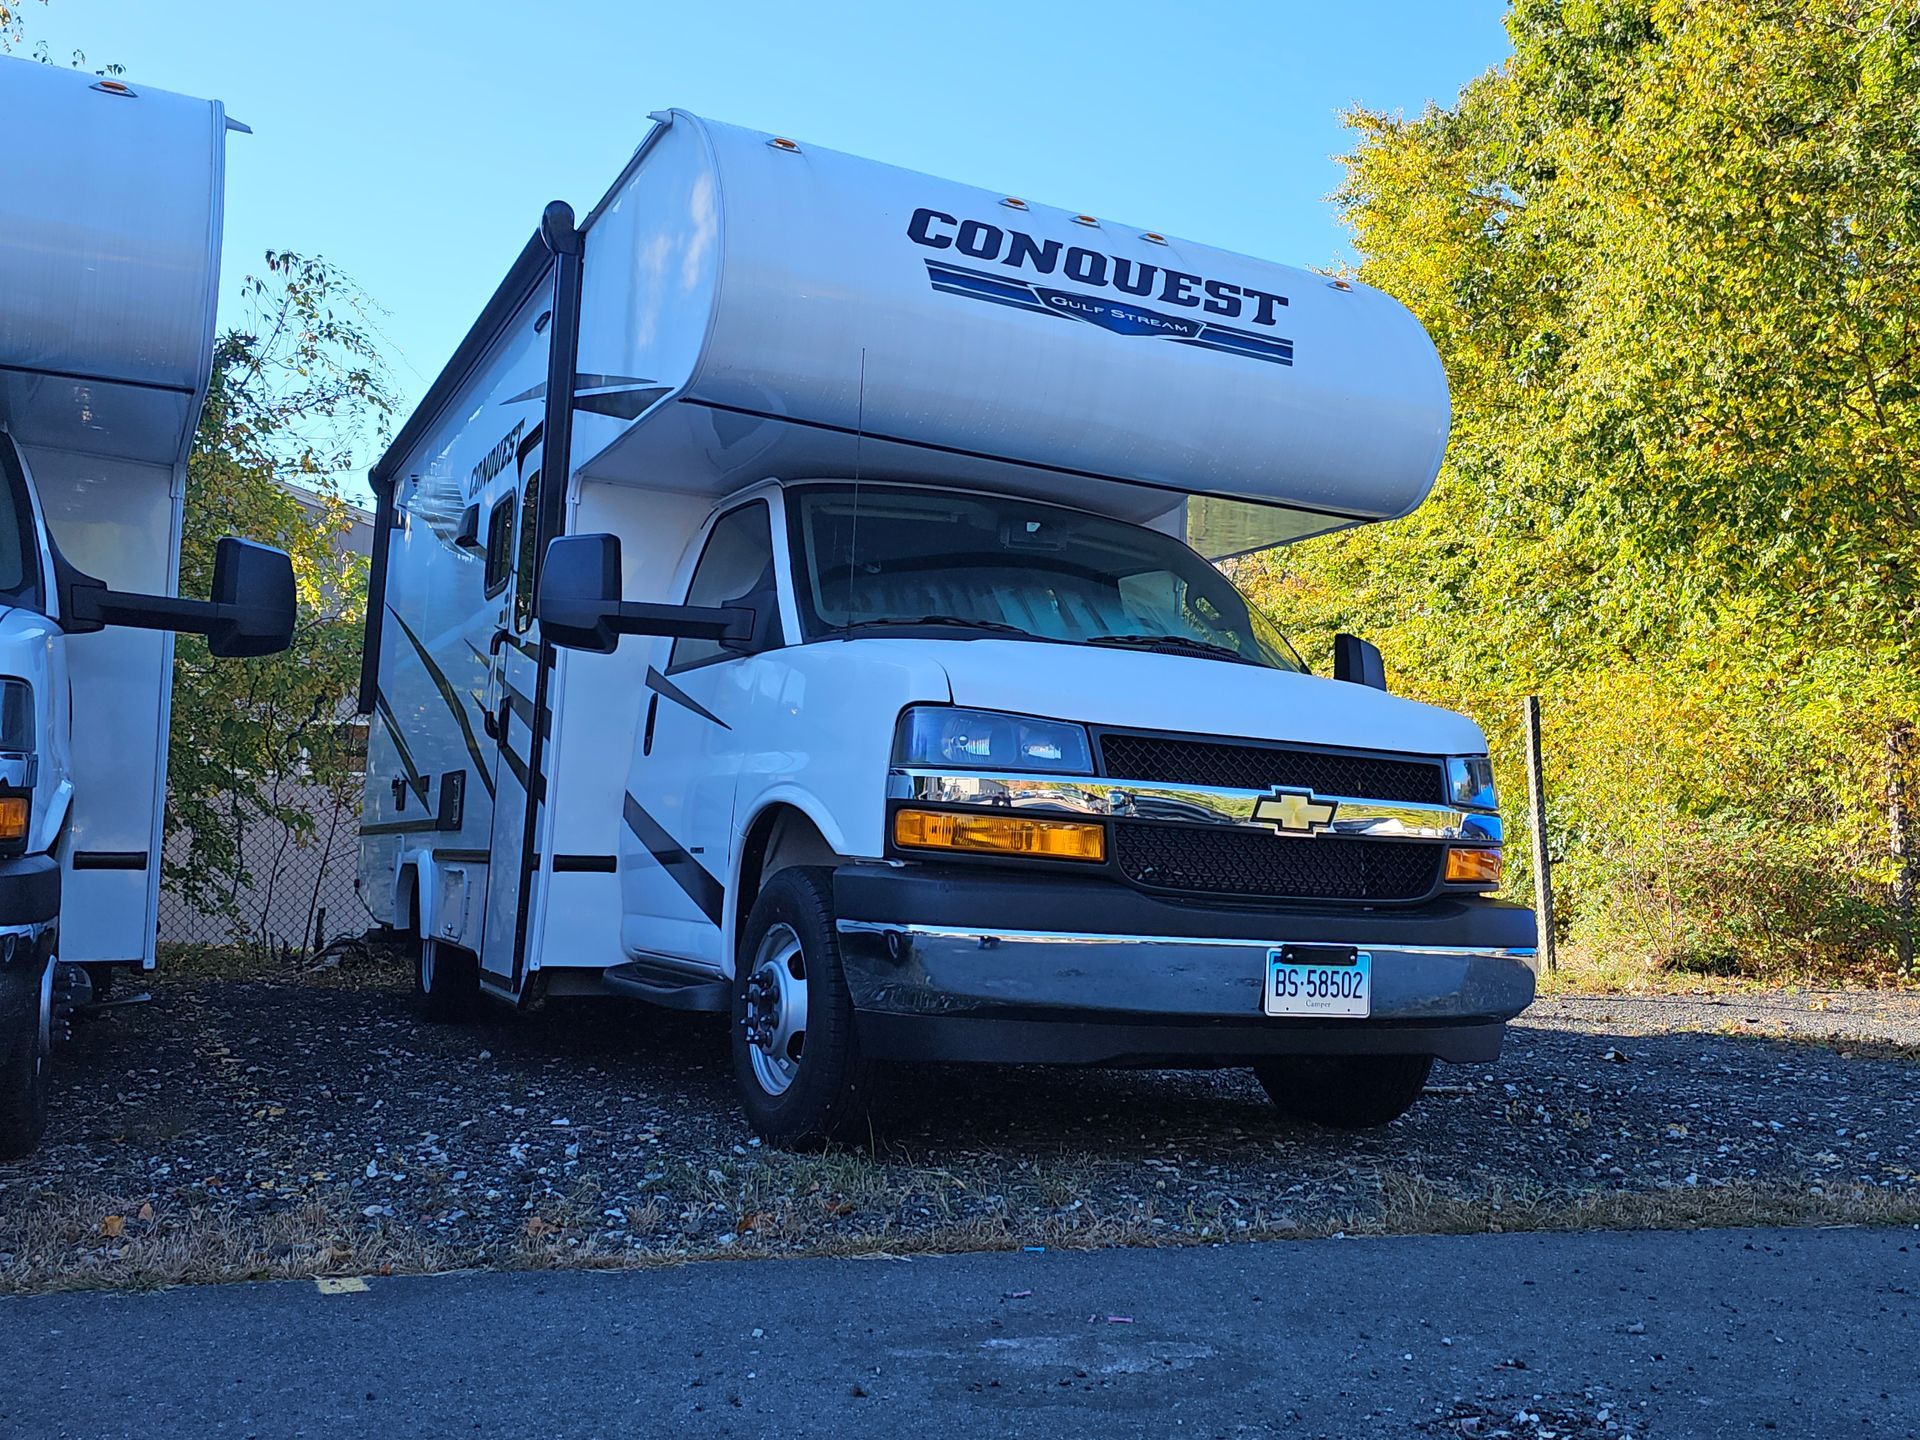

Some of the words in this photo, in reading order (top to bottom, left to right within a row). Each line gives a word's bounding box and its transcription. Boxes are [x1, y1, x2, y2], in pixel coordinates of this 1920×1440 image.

[906, 207, 1289, 326] CONQUEST
[1050, 296, 1105, 314] GULF
[1110, 309, 1189, 333] STREAM
[468, 416, 526, 500] CONQUEST
[1305, 999, 1331, 1008] Camper
